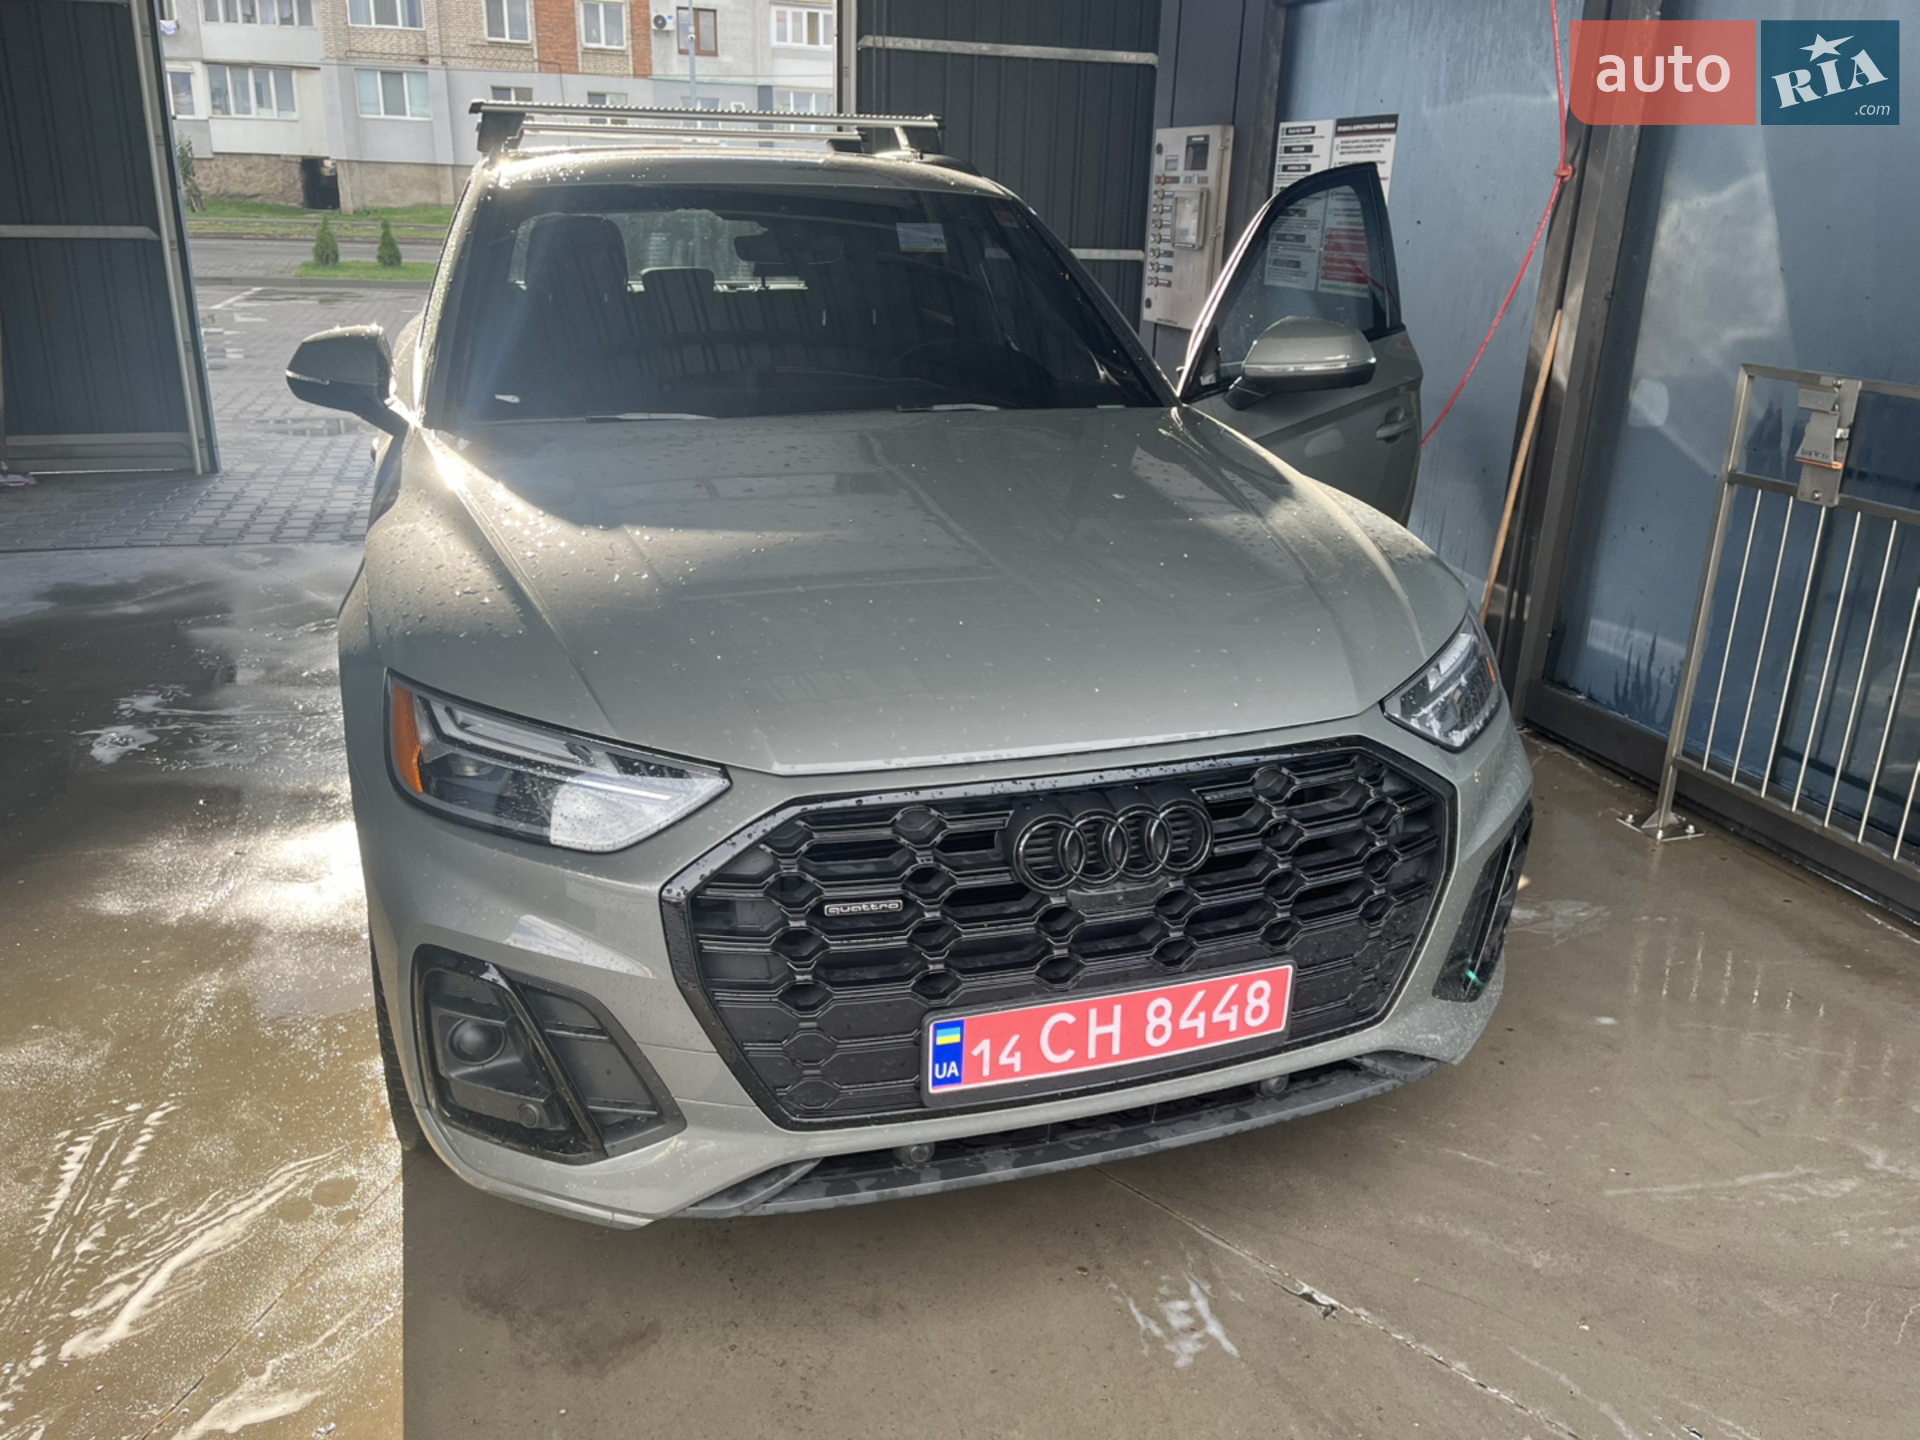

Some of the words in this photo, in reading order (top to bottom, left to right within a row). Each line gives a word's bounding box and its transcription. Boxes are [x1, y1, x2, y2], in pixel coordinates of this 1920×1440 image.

[828, 902, 899, 915] quattro
[971, 1034, 1022, 1077] 14
[1039, 1004, 1121, 1064] CH
[1145, 980, 1271, 1049] 8448
[934, 1061, 960, 1079] UA
